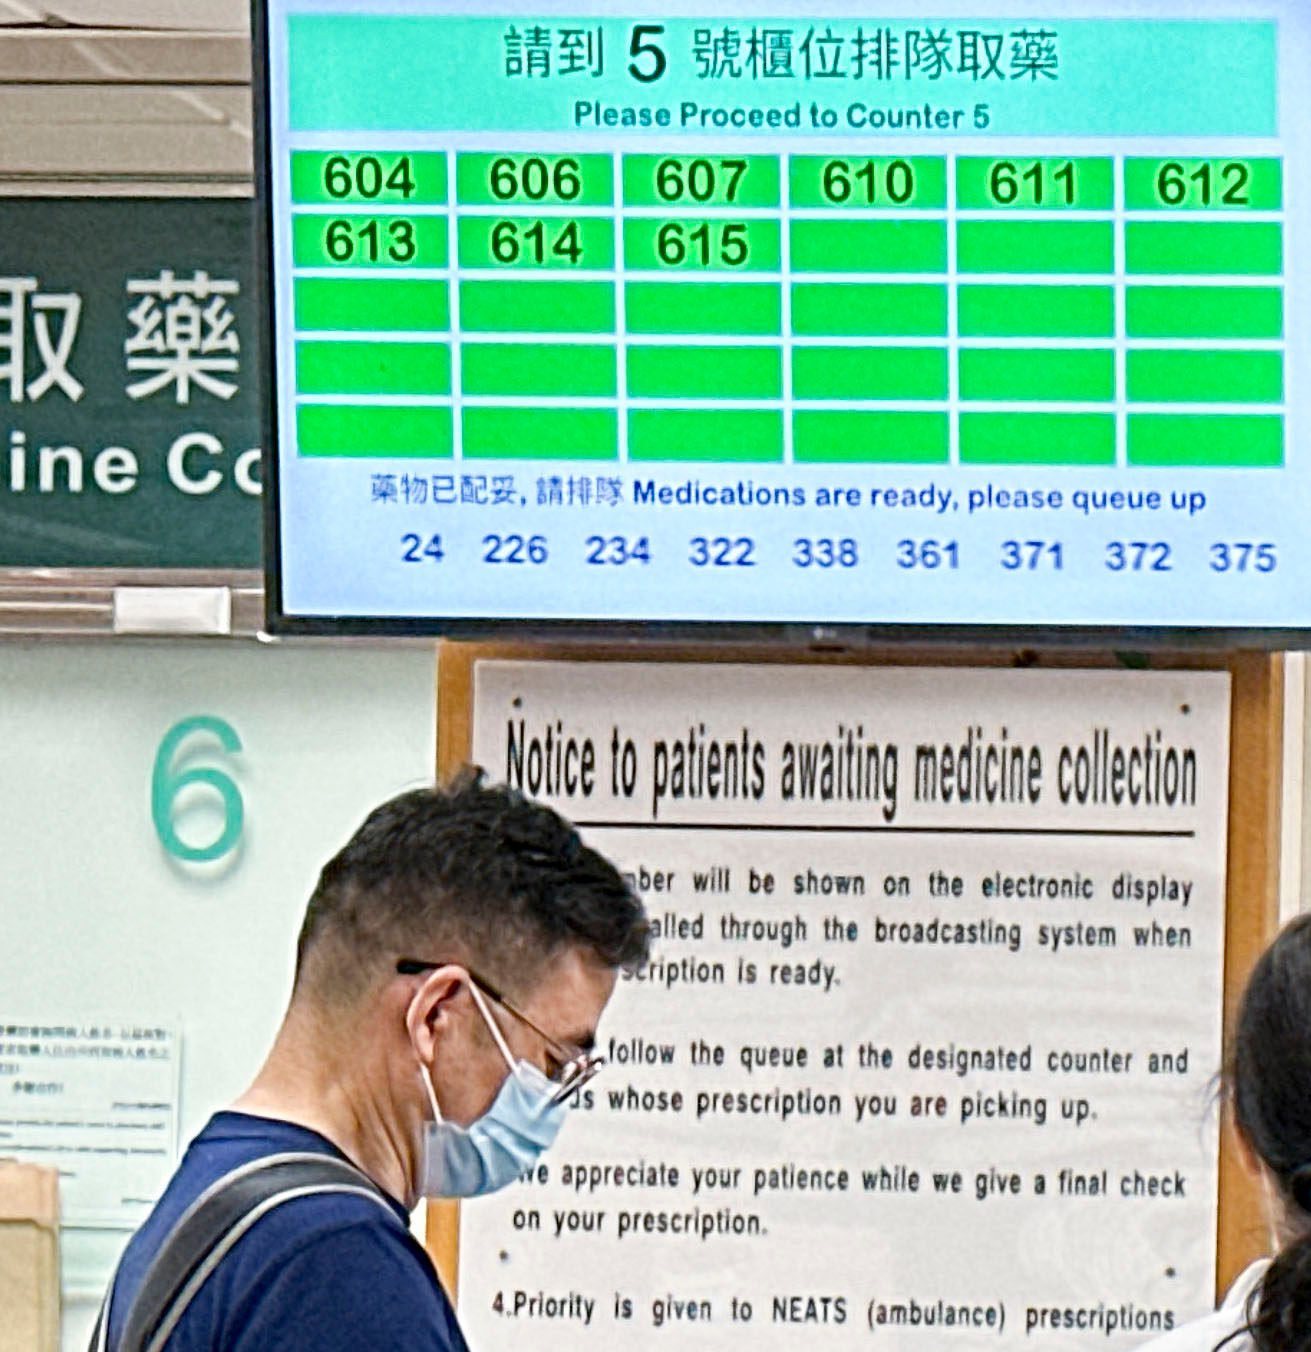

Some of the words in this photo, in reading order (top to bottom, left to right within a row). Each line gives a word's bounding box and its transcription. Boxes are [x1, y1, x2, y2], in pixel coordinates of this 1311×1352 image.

[504, 26, 603, 77] 請到
[629, 26, 666, 82] 5
[693, 27, 1057, 81] 號櫃位排隊取藥
[575, 101, 670, 126] Please
[681, 102, 800, 127] Proceed
[810, 103, 837, 128] to
[847, 103, 964, 128] Counter
[974, 104, 989, 129] 5
[325, 157, 415, 198] 604
[491, 159, 580, 200] 606
[657, 160, 746, 201] 607
[824, 161, 913, 203] 610
[991, 162, 1073, 204] 611
[1158, 163, 1248, 205] 612
[326, 221, 415, 262] 613
[492, 222, 581, 263] 614
[659, 224, 747, 265] 615
[0, 270, 240, 404] 取藥
[11, 431, 138, 492] ine
[536, 476, 622, 507] 請排隊
[634, 480, 805, 505] Medications
[816, 488, 861, 506] are
[871, 483, 958, 513] ready,
[969, 484, 1062, 513] please
[1073, 491, 1158, 514] queue
[1171, 492, 1206, 515] up
[402, 534, 444, 562] 24
[483, 535, 547, 564] 226
[586, 536, 650, 565] 234
[690, 537, 755, 566] 322
[793, 538, 858, 568] 338
[898, 540, 958, 568] 361
[1002, 540, 1062, 569] 371
[1106, 542, 1171, 571] 372
[1210, 543, 1276, 572] 375
[151, 715, 244, 863] 6
[506, 718, 596, 798] Notice
[612, 727, 636, 797] to
[653, 723, 764, 818] patients
[782, 725, 897, 822] awaiting
[915, 727, 1041, 803] medicine
[1058, 729, 1196, 806] collection
[693, 867, 729, 892] will
[749, 869, 774, 894] be
[794, 869, 864, 895] shown
[884, 876, 909, 896] on
[929, 871, 963, 897] the
[982, 872, 1093, 899] electronic
[1112, 874, 1192, 907] display
[650, 911, 704, 940] alled
[721, 913, 806, 948] through
[824, 916, 857, 942] the
[875, 917, 1020, 952] broadcasting
[1039, 922, 1116, 952] system
[1134, 921, 1191, 947] when
[621, 954, 726, 989] scription
[738, 958, 756, 984] is
[771, 959, 840, 991] ready.
[609, 1038, 674, 1064] follow
[691, 1040, 724, 1066] the
[741, 1047, 807, 1072] queue
[824, 1045, 843, 1068] at
[859, 1043, 892, 1068] the
[908, 1045, 1031, 1077] designated
[1048, 1048, 1132, 1073] counter
[1149, 1048, 1188, 1074] and
[608, 1085, 682, 1111] whose
[697, 1088, 840, 1121] prescription
[855, 1096, 896, 1122] you
[911, 1096, 947, 1116] are
[961, 1092, 1046, 1125] picking
[1062, 1100, 1095, 1126] up.
[562, 1162, 679, 1192] appreciate
[693, 1168, 741, 1194] your
[754, 1164, 848, 1196] patience
[862, 1166, 919, 1192] while
[933, 1173, 962, 1193] we
[976, 1168, 1020, 1200] give
[1035, 1175, 1045, 1194] a
[1059, 1170, 1107, 1195] final
[1121, 1170, 1185, 1197] check
[513, 1210, 540, 1229] on
[554, 1211, 604, 1237] your
[618, 1208, 766, 1240] prescription.
[493, 1291, 594, 1325] 4.Priority
[615, 1293, 632, 1319] is
[653, 1295, 711, 1327] given
[732, 1298, 752, 1321] to
[773, 1297, 846, 1324] NEATS
[868, 1300, 1005, 1331] (ambulance)
[1026, 1305, 1174, 1336] prescriptions
